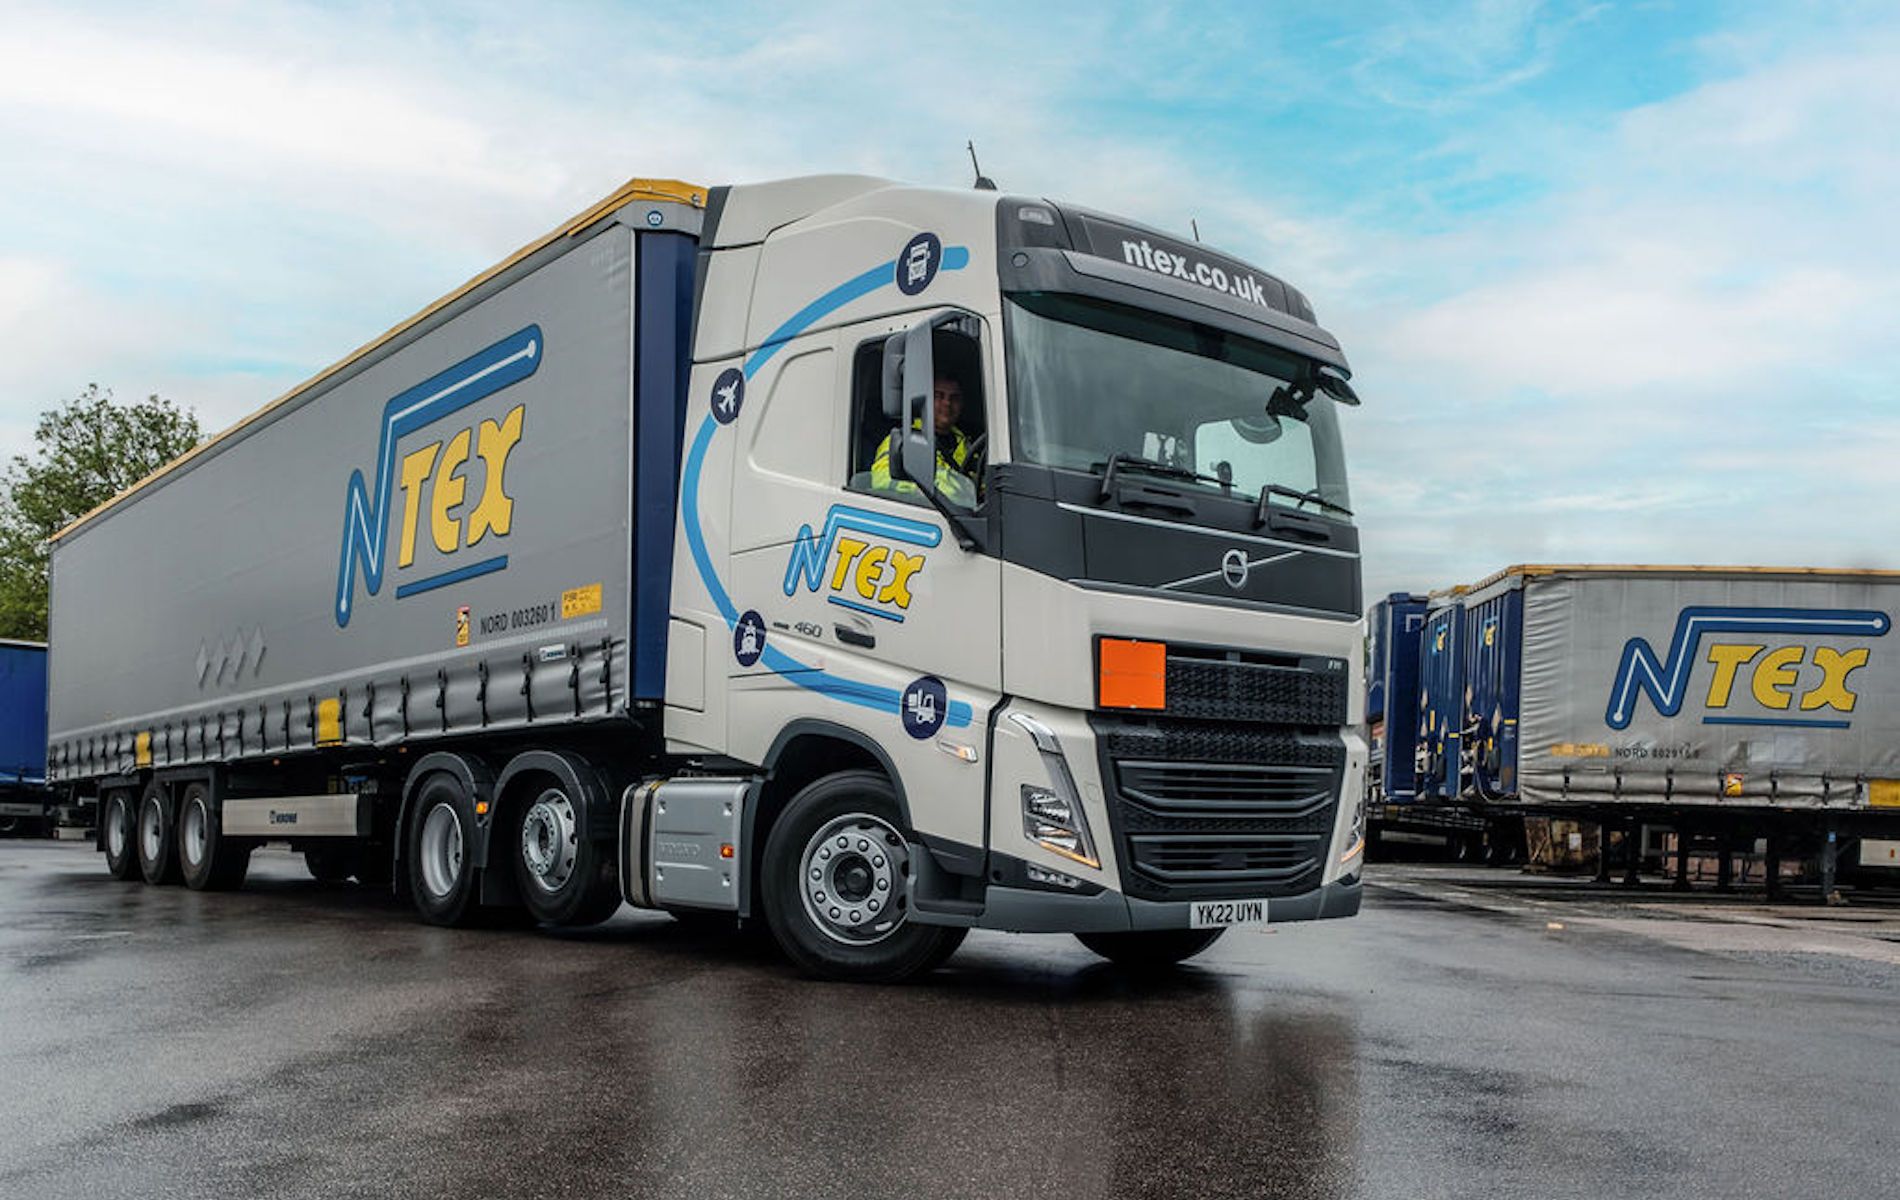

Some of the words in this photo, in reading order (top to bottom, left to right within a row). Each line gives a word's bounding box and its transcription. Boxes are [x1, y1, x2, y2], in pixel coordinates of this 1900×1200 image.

[1122, 240, 1269, 307] ntex.co.uk
[336, 323, 544, 628] NTEX
[783, 503, 943, 610] NTEX
[480, 613, 508, 635] NORD
[794, 622, 823, 638] 460
[1605, 606, 1891, 730] NTEX
[1615, 747, 1648, 760] NORD
[1198, 903, 1234, 925] YK22
[1236, 902, 1263, 922] UYN
